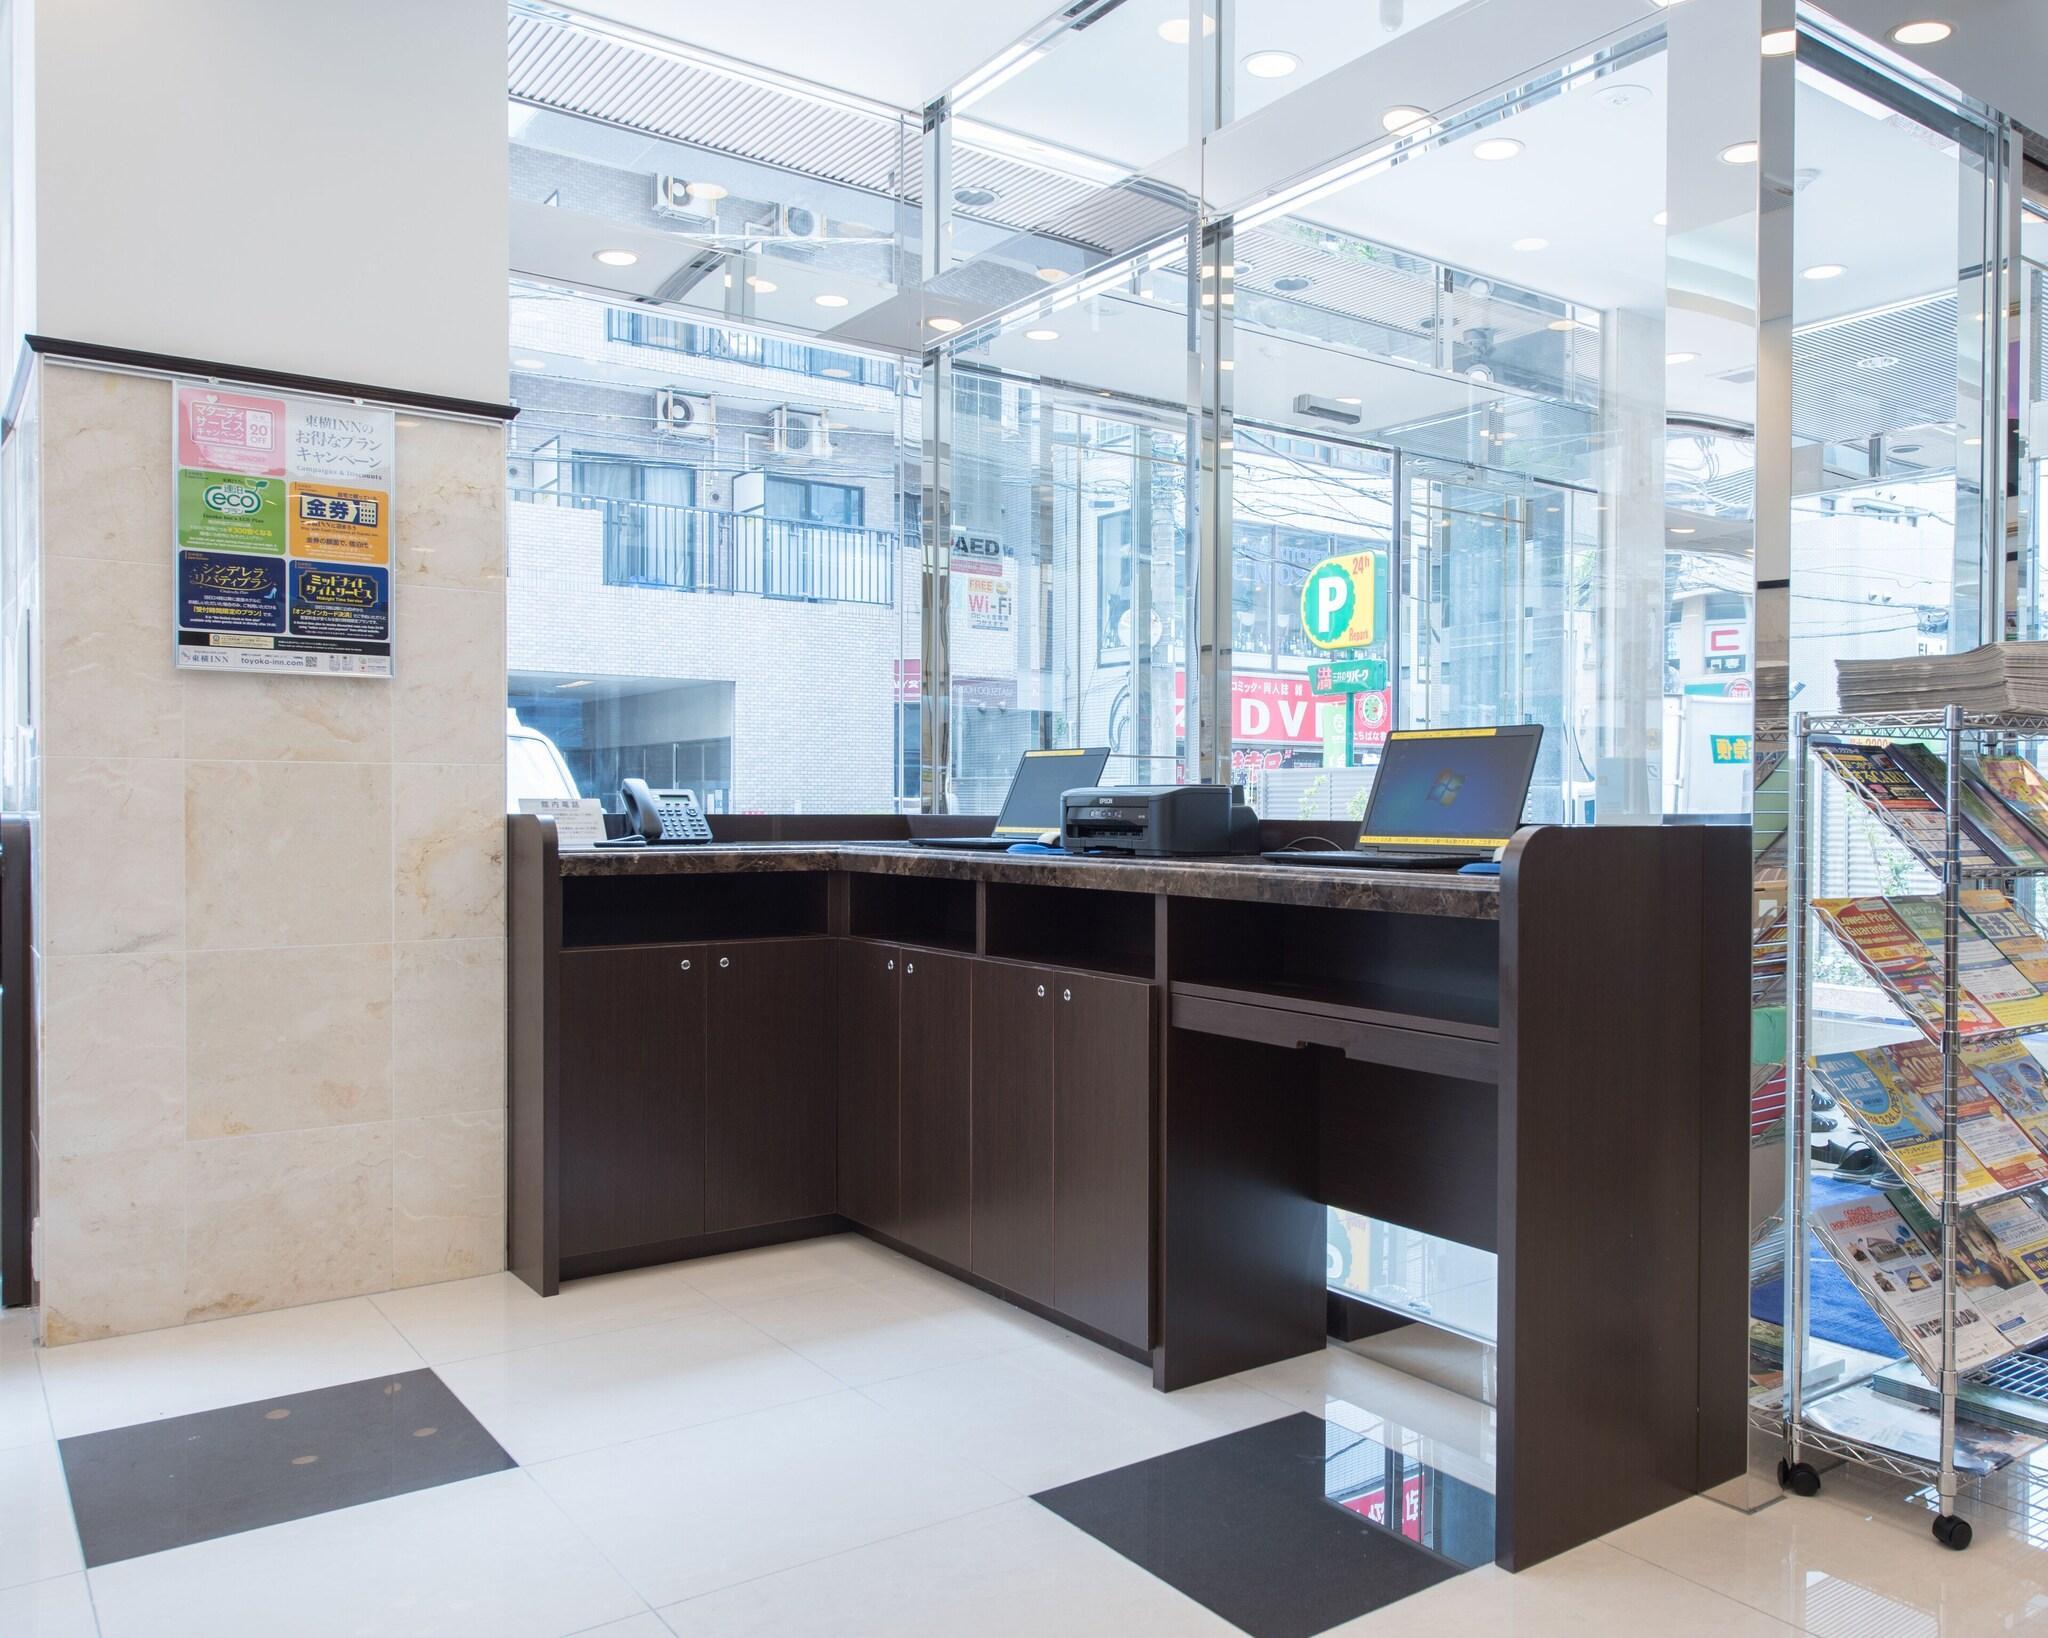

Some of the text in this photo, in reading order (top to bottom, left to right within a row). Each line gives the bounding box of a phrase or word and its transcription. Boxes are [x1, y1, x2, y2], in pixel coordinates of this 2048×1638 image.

[197, 416, 245, 432] サービス
[305, 414, 374, 434] 東横INNの
[296, 430, 382, 451] お得なプラン
[212, 492, 254, 508] eco
[306, 498, 349, 520] 金券
[953, 536, 1000, 556] AED
[202, 563, 265, 578] シンデレラ
[1352, 556, 1370, 575] 24h
[310, 574, 367, 588] ミッドナイト
[969, 579, 993, 591] FREE
[305, 584, 373, 599] タイムサービス
[968, 594, 1012, 615] Wi-Fi
[1318, 577, 1348, 633] P
[192, 655, 230, 664] 東横INN
[241, 656, 304, 667] toyoko-inn.com
[1332, 669, 1369, 683] 三井のリパーク
[1839, 913, 1868, 926] Lowest
[1868, 912, 1893, 924] Price
[1846, 921, 1901, 937] Guarantee!
